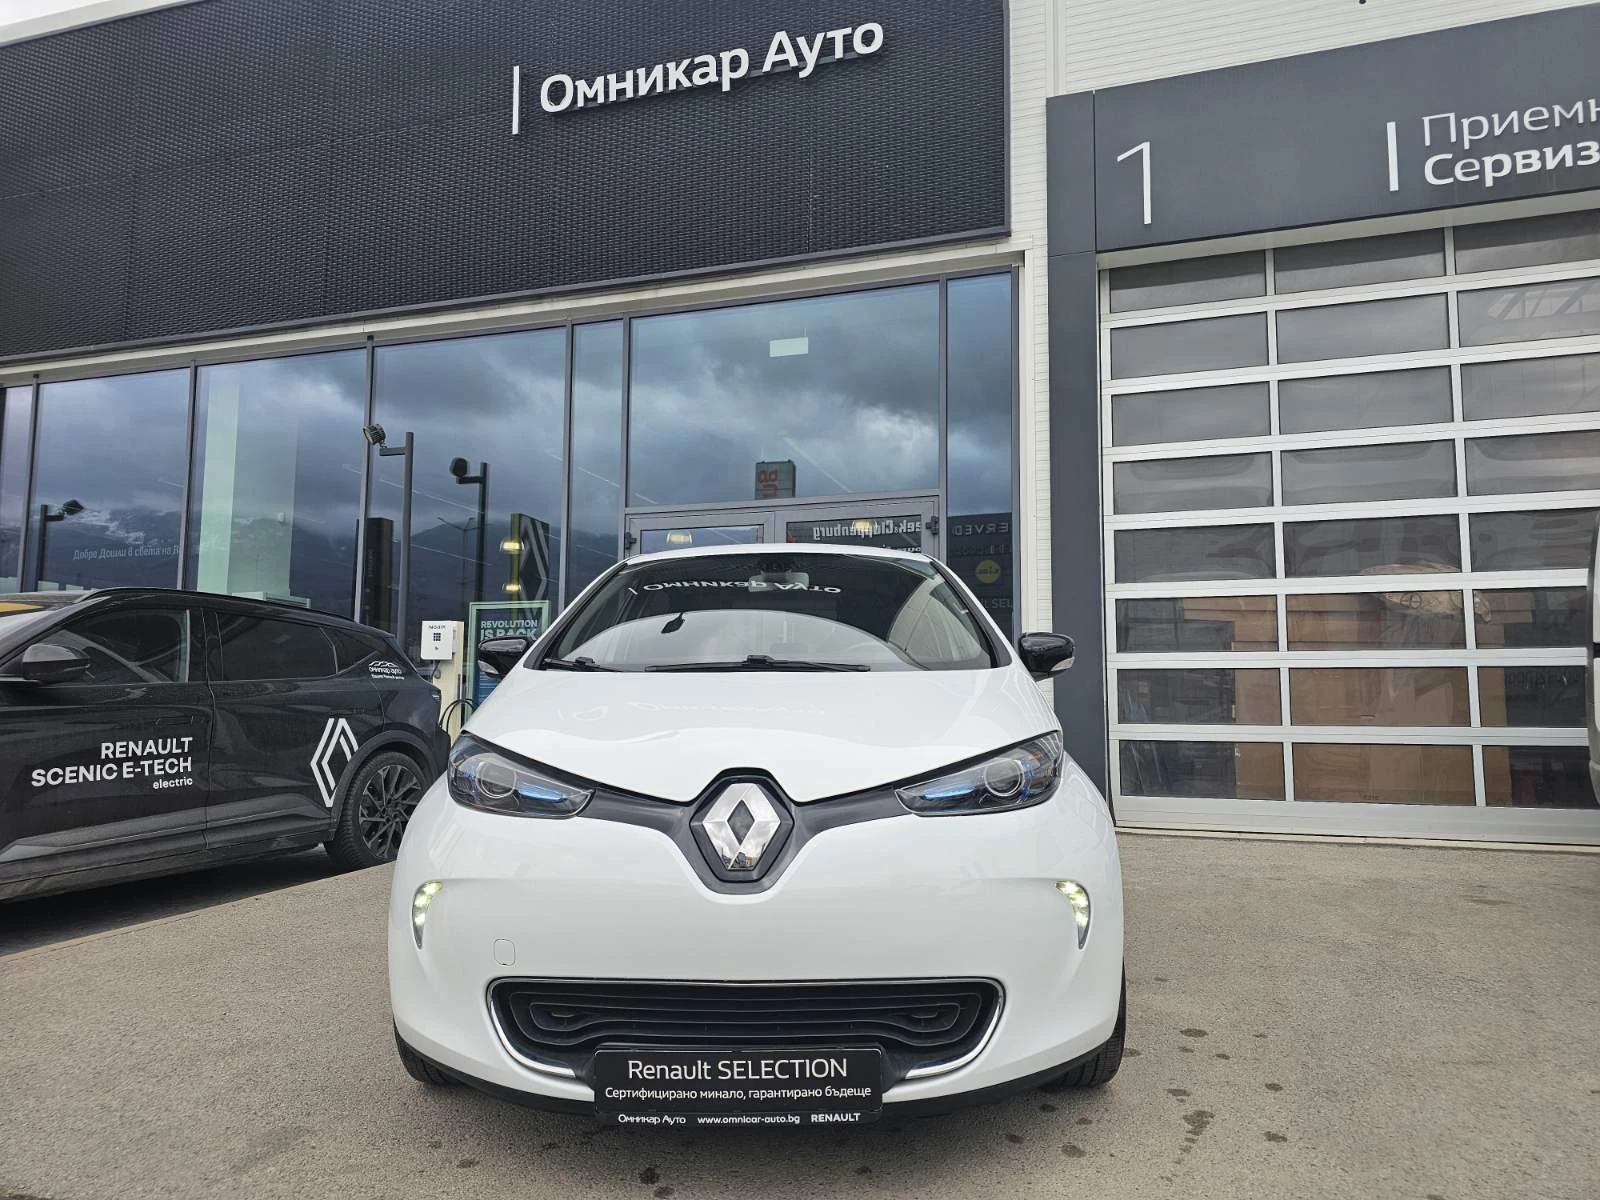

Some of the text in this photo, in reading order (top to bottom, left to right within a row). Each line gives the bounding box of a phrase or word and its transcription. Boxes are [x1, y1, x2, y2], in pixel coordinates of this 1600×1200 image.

[540, 22, 884, 113] Омникар Ауто
[1424, 140, 1600, 188] Сервиз
[1116, 141, 1152, 225] 1
[101, 737, 193, 759] RENAULT
[31, 756, 192, 787] SCENIC E-TECH
[152, 776, 193, 790] electric
[628, 1058, 848, 1080] Renault SELECTION
[605, 1085, 872, 1101] Сертифицирано минало, гарантирано бъдеще
[618, 1114, 686, 1125] Омникар Ауто
[697, 1114, 800, 1125] www.omnicar-auto.bg
[811, 1113, 860, 1123] RENAULT
